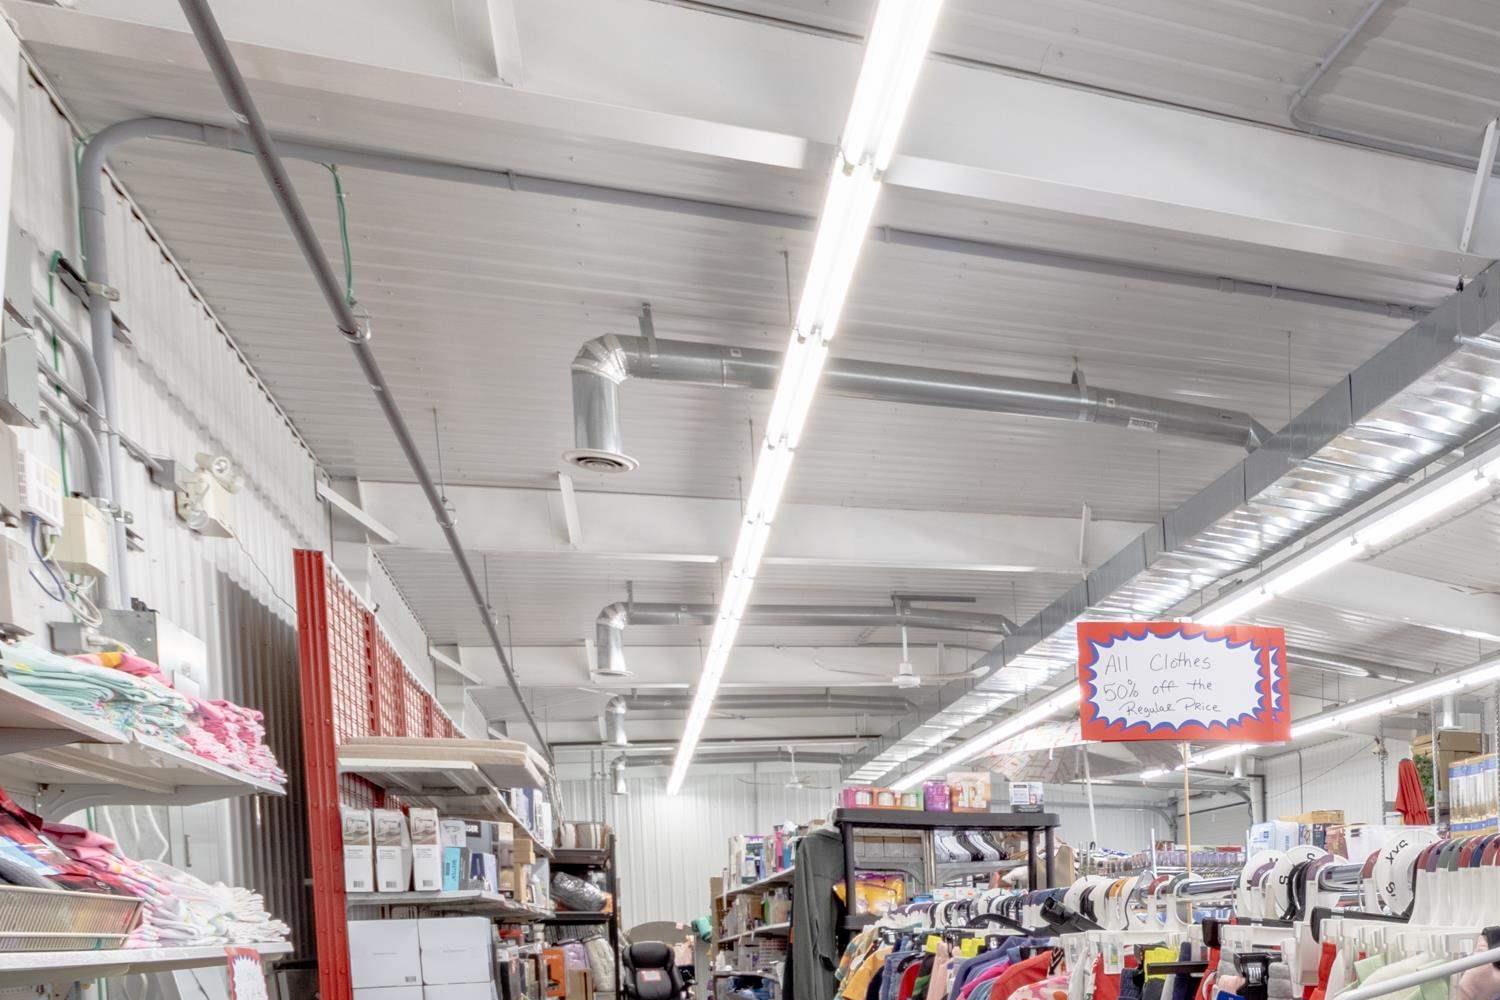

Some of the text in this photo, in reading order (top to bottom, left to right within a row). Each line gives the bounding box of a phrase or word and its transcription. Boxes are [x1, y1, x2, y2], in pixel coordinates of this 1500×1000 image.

[1105, 652, 1212, 675] All Clothes
[1103, 678, 1213, 701] 50% off the
[1119, 700, 1176, 718] Regular
